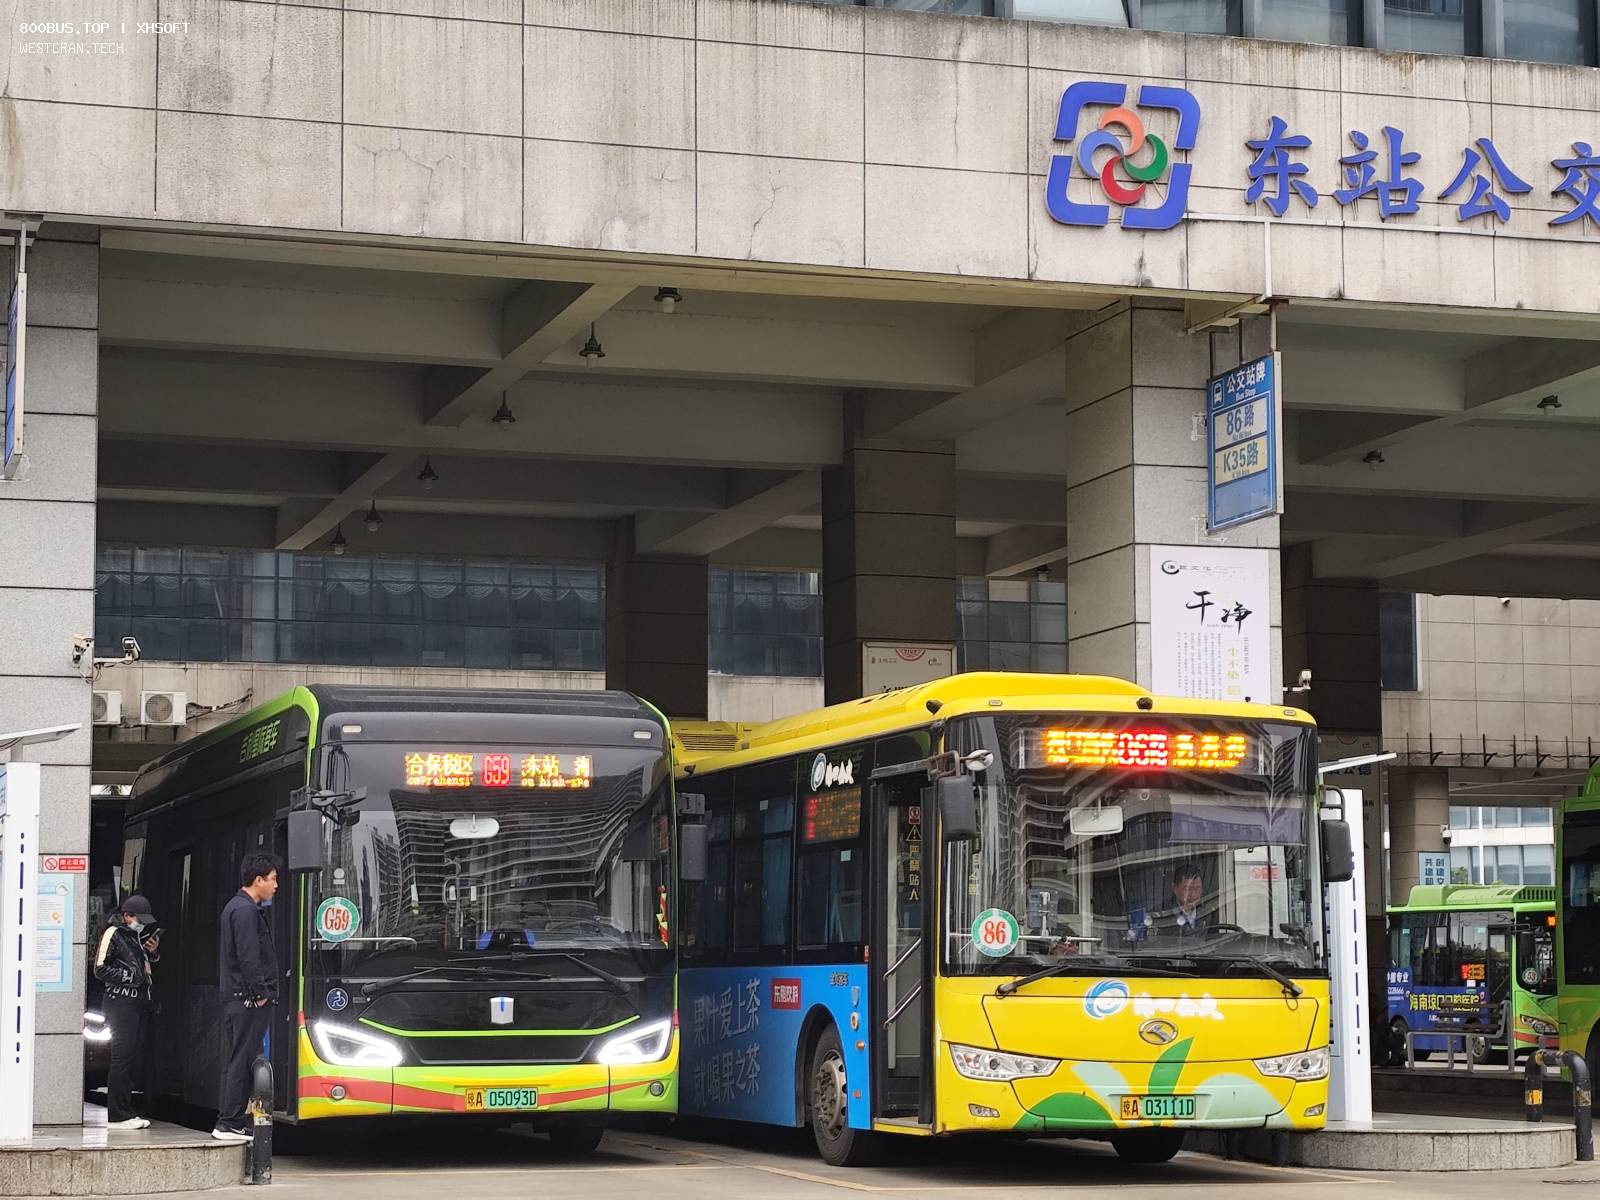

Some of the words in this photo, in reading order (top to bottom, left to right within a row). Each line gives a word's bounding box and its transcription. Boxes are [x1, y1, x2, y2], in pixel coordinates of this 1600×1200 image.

[1246, 115, 1600, 227] 东站公交
[1226, 361, 1266, 394] 公交站牌
[1226, 404, 1254, 436] 86路
[1223, 440, 1259, 473] K35路
[483, 755, 511, 785] G59
[521, 753, 559, 777] 东站
[324, 907, 350, 930] G59
[984, 920, 1007, 944] 86
[693, 977, 761, 1048] 果汁爱上茶
[489, 1090, 537, 1106] 05093D
[1145, 1098, 1194, 1116] 03111D
